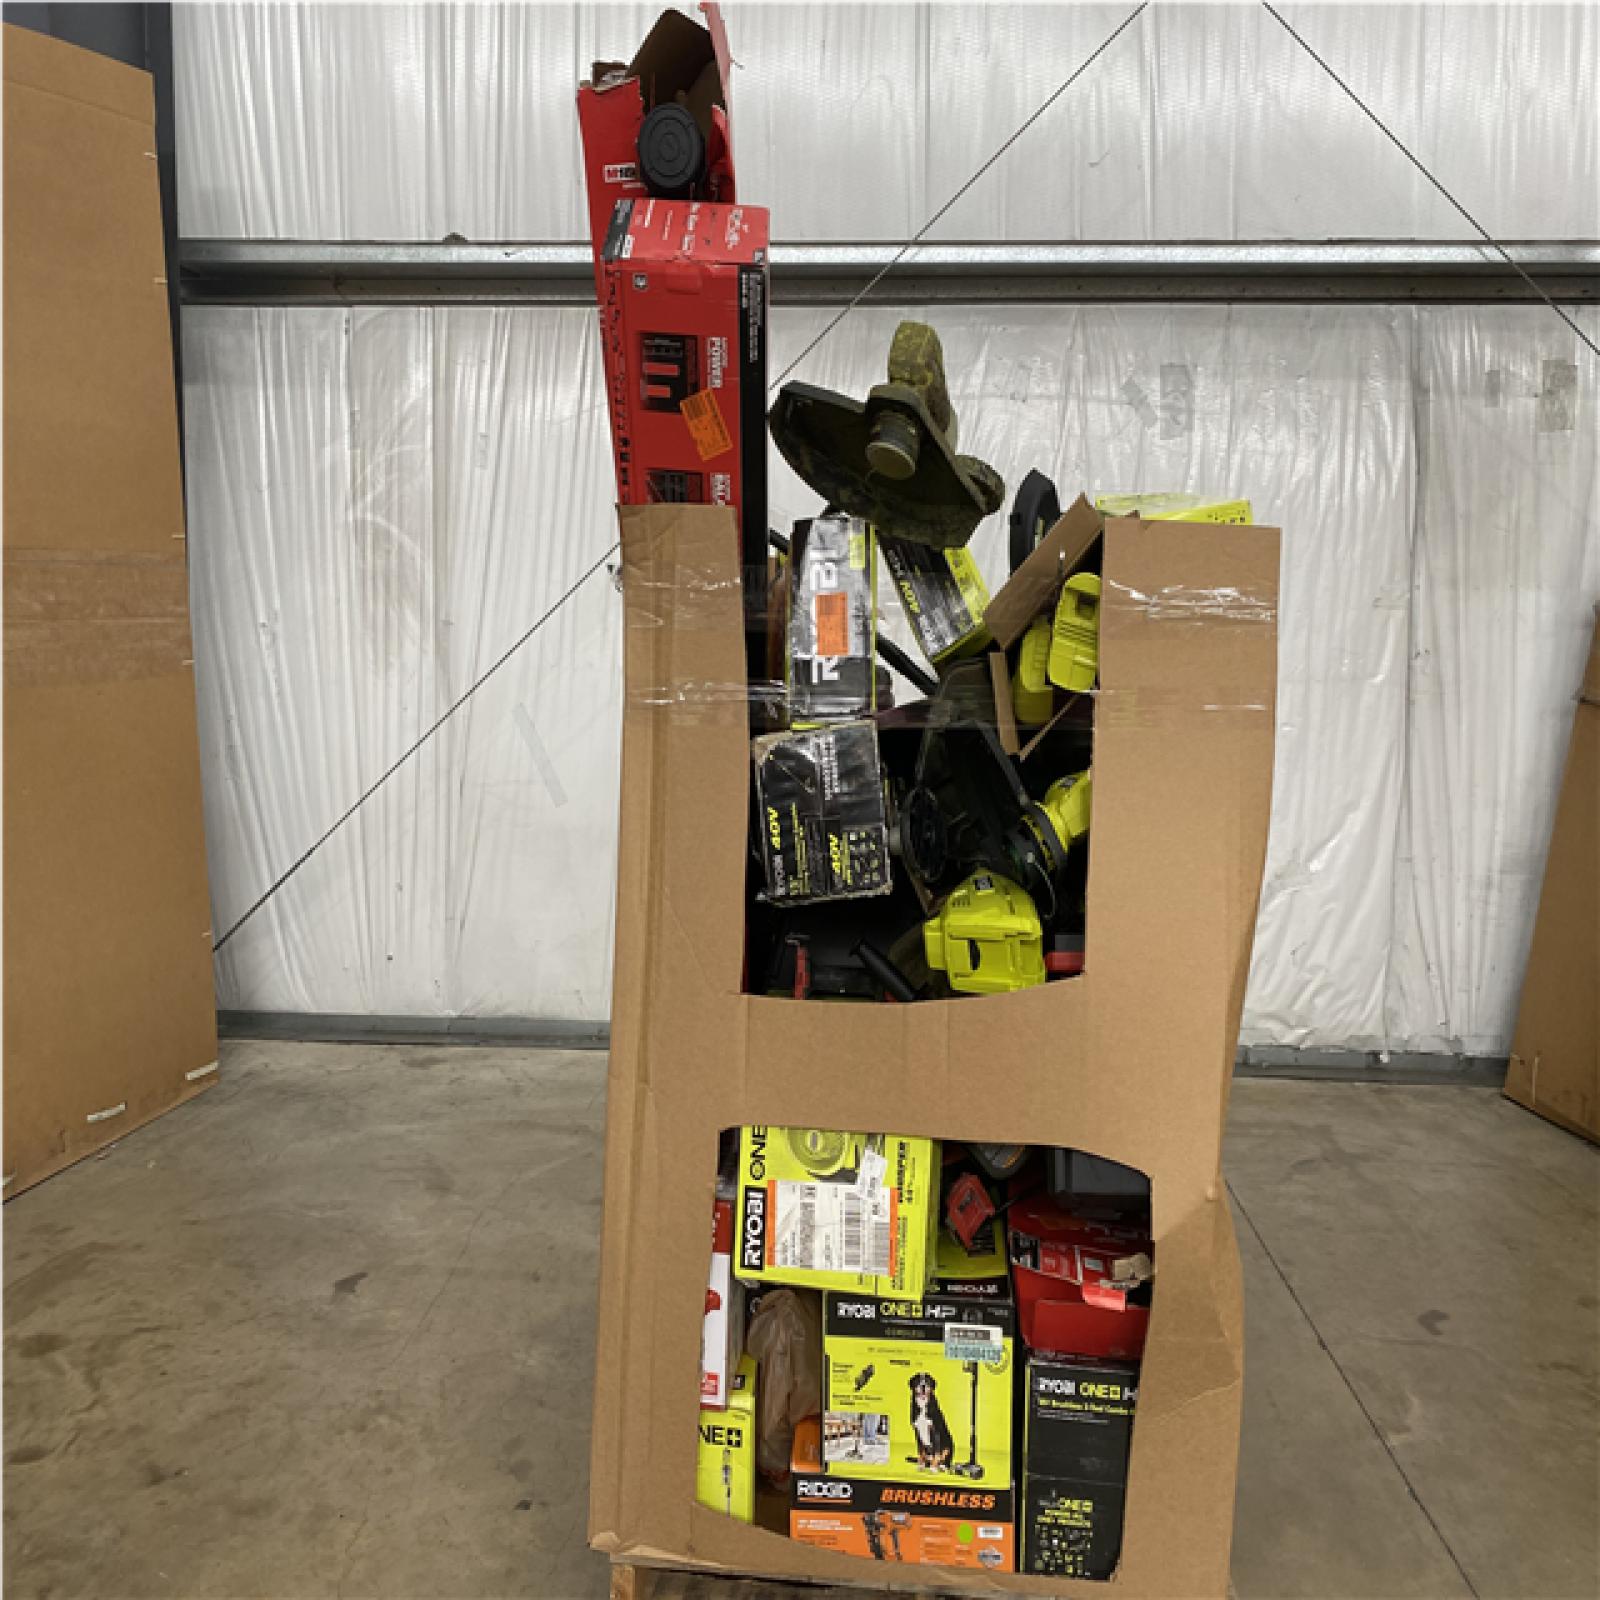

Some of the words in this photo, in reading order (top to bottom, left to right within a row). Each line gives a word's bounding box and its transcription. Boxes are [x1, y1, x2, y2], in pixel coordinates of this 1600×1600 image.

[710, 336, 723, 389] POWER
[744, 1191, 764, 1267] RYOBI
[836, 1302, 876, 1318] RYOBI
[924, 1304, 956, 1318] HP
[1038, 1377, 1076, 1395] RYOBI
[797, 1479, 853, 1499] RIDGID
[880, 1488, 996, 1511] BRUSHLESS
